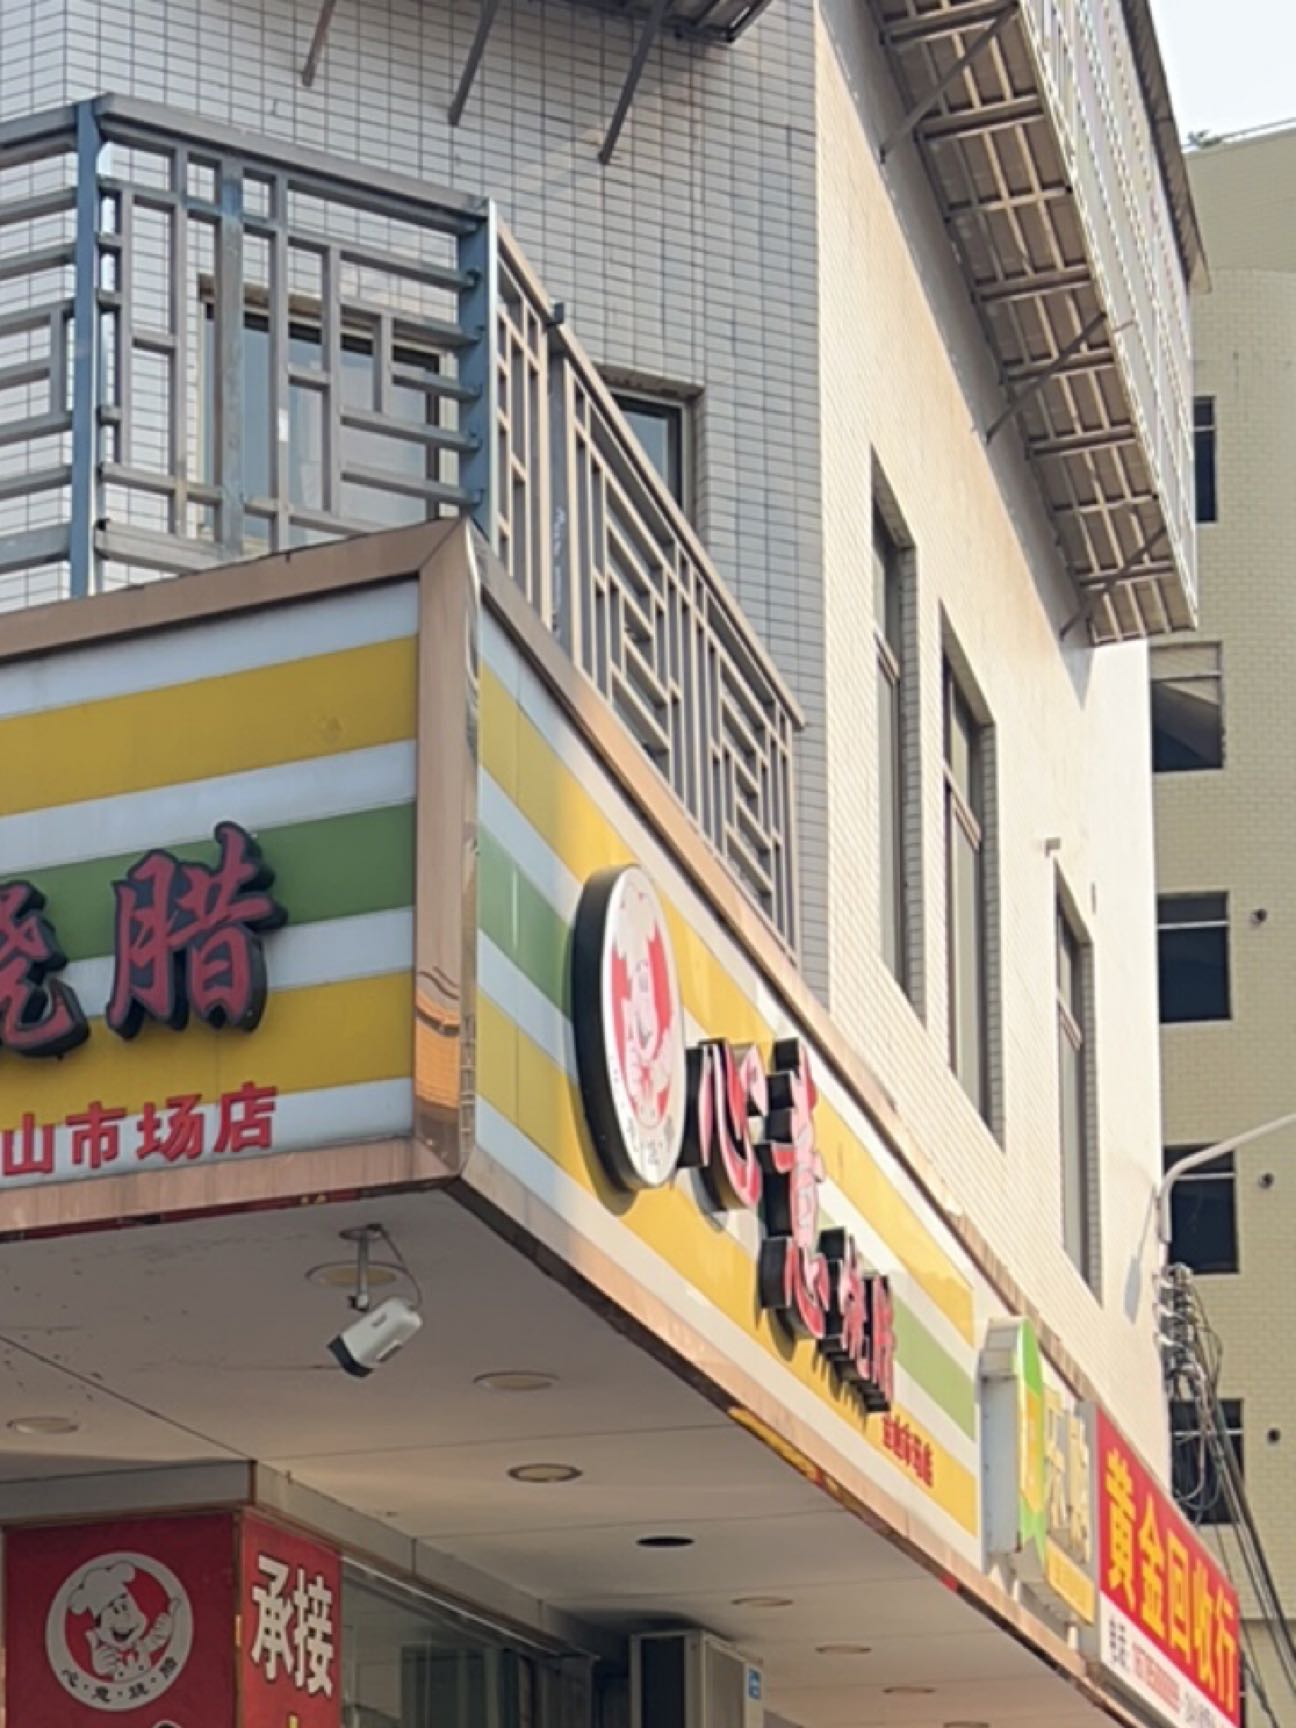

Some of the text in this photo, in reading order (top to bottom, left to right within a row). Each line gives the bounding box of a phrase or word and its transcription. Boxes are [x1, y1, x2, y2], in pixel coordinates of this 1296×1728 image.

[250, 1554, 334, 1698] 承接
[1102, 1448, 1237, 1712] 黄金回收行
